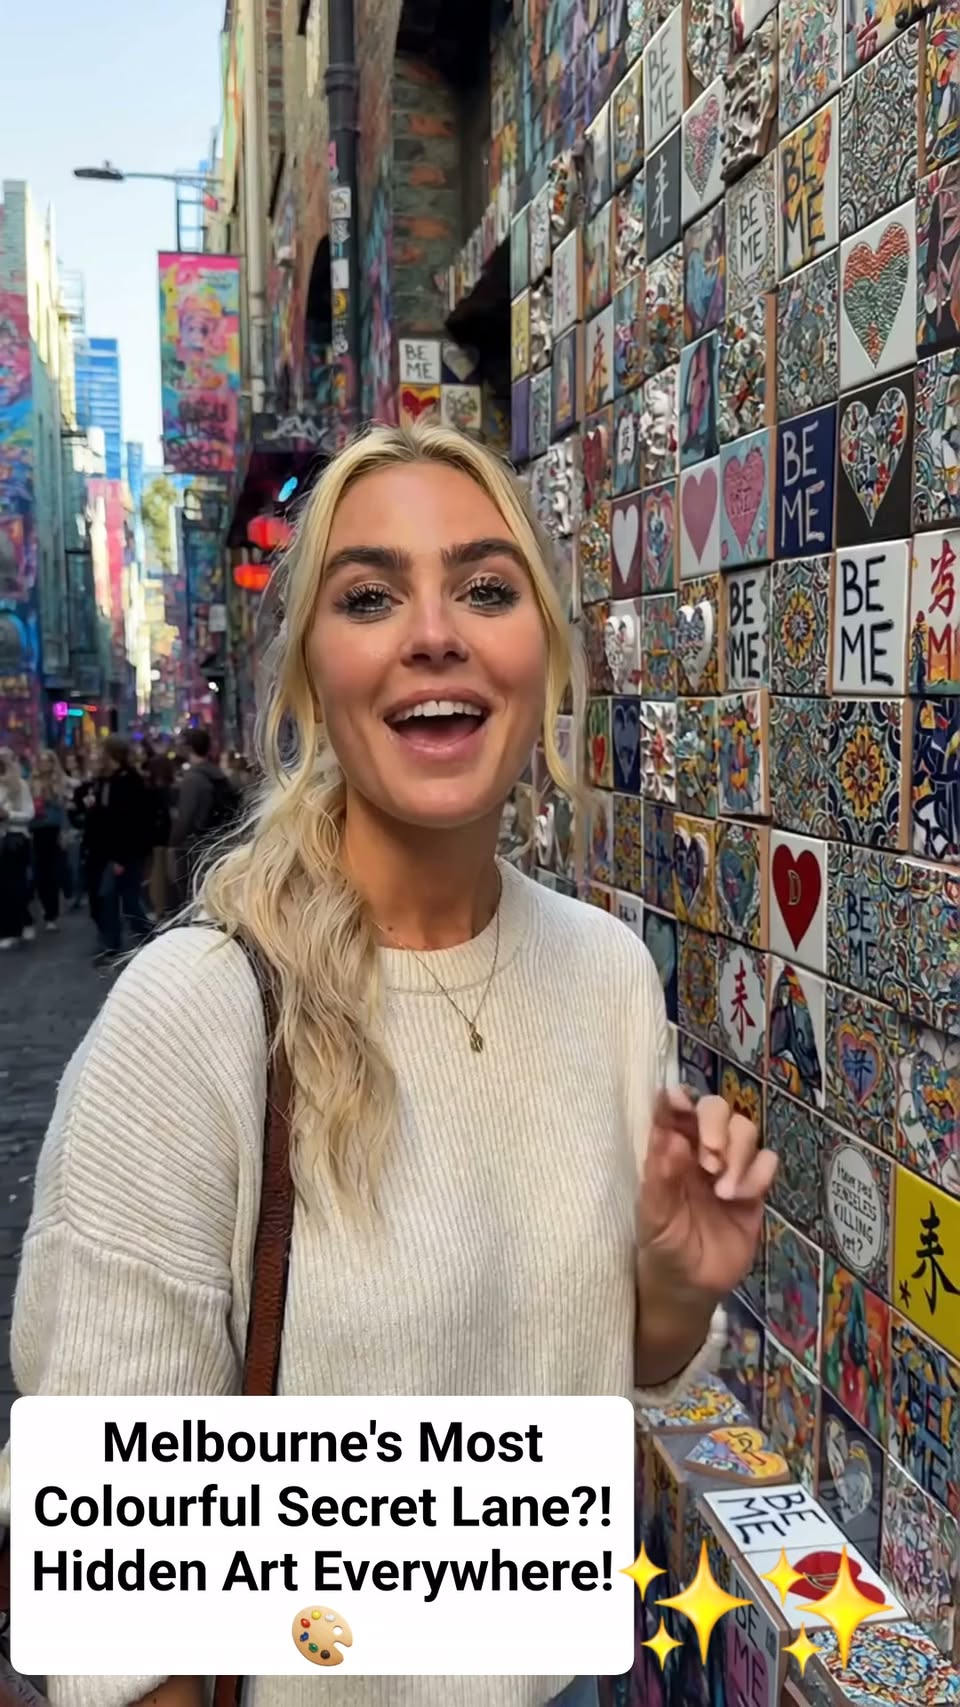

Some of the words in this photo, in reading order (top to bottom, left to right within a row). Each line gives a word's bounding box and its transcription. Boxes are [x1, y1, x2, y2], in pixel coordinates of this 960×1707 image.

[648, 27, 671, 90] BE
[648, 68, 677, 141] ME
[781, 116, 817, 203] BE
[739, 193, 758, 235] BE
[781, 183, 826, 268] ME
[740, 228, 763, 271] ME
[404, 344, 429, 361] BE
[406, 362, 433, 379] ME
[782, 420, 819, 487] BE
[780, 480, 825, 548] ME
[729, 579, 756, 627] BE
[839, 554, 886, 616] BE
[730, 631, 761, 679] ME
[840, 619, 894, 687] ME
[847, 889, 872, 933] BE
[848, 938, 878, 980] ME
[718, 1497, 787, 1545] ME
[761, 1491, 827, 1526] BE
